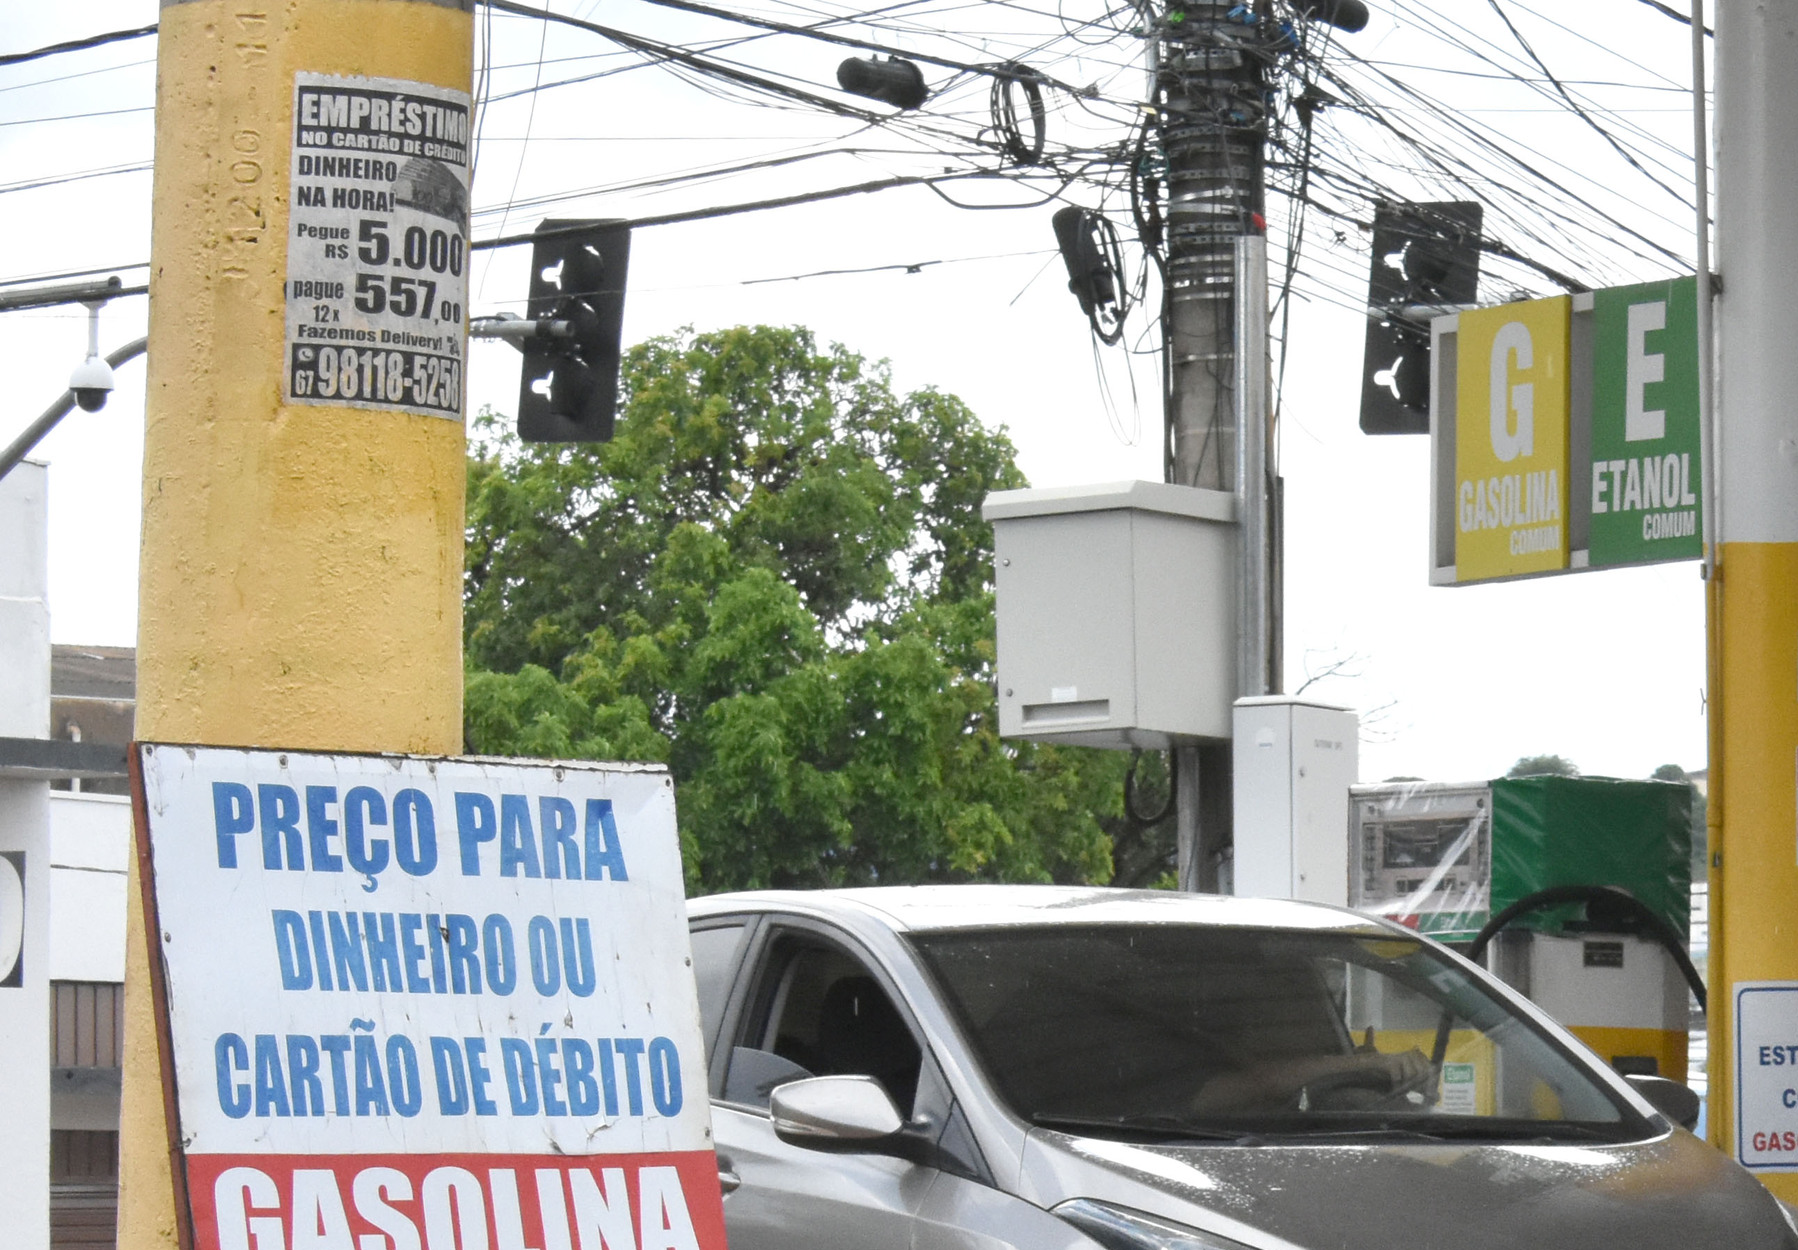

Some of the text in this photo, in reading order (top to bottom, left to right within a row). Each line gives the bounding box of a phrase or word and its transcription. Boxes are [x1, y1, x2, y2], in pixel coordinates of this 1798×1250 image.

[301, 93, 467, 146] EMPRÉSTIMO
[298, 155, 398, 183] DINHEIRO
[301, 131, 466, 166] NO CARTÃO DE CRÉDITO
[297, 186, 396, 213] NA HORA!
[297, 223, 350, 241] Pegue
[324, 219, 463, 278] R$ 5.000
[293, 280, 344, 300] pague
[313, 305, 329, 323] 12
[354, 273, 461, 326] 557,00
[298, 324, 442, 350] Fazemos Delivery!
[295, 347, 460, 411] 67 98118-5258
[1489, 321, 1534, 462] G
[1625, 301, 1666, 442] E
[1459, 469, 1560, 533] GASOLINA
[1592, 452, 1695, 515] ETANOL
[1510, 525, 1560, 557] COMUM
[1643, 511, 1695, 541] COMUM
[211, 781, 629, 893] PREÇO PARA
[271, 910, 596, 998] DINHEIRO OU
[214, 1017, 684, 1119] CARTÃO DE DÉBITO
